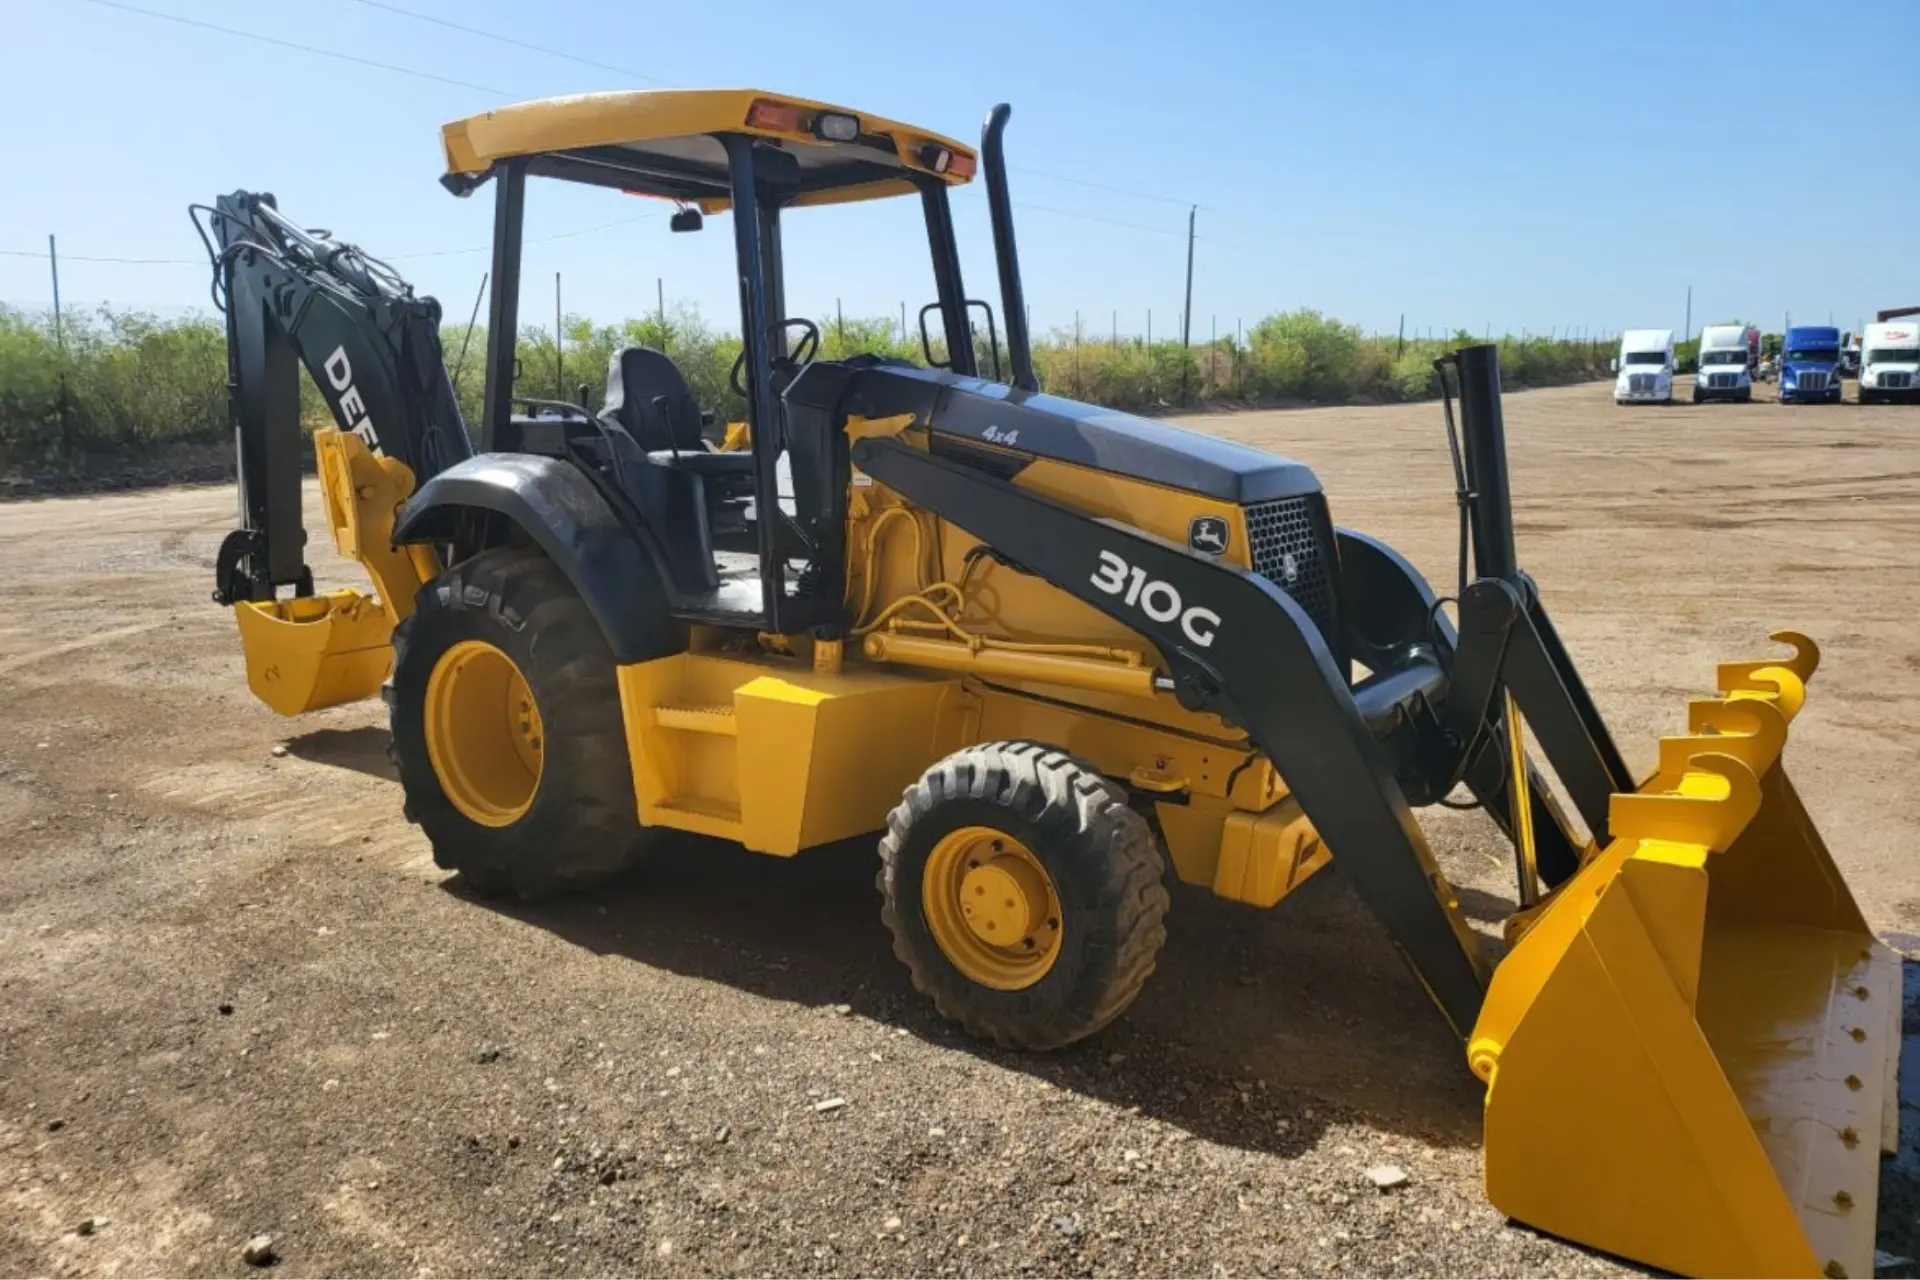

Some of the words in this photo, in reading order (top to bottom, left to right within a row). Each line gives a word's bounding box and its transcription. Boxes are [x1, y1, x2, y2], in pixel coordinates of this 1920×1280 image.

[324, 344, 384, 459] DEE
[982, 425, 1019, 446] 4x4
[1089, 549, 1222, 647] 310G
